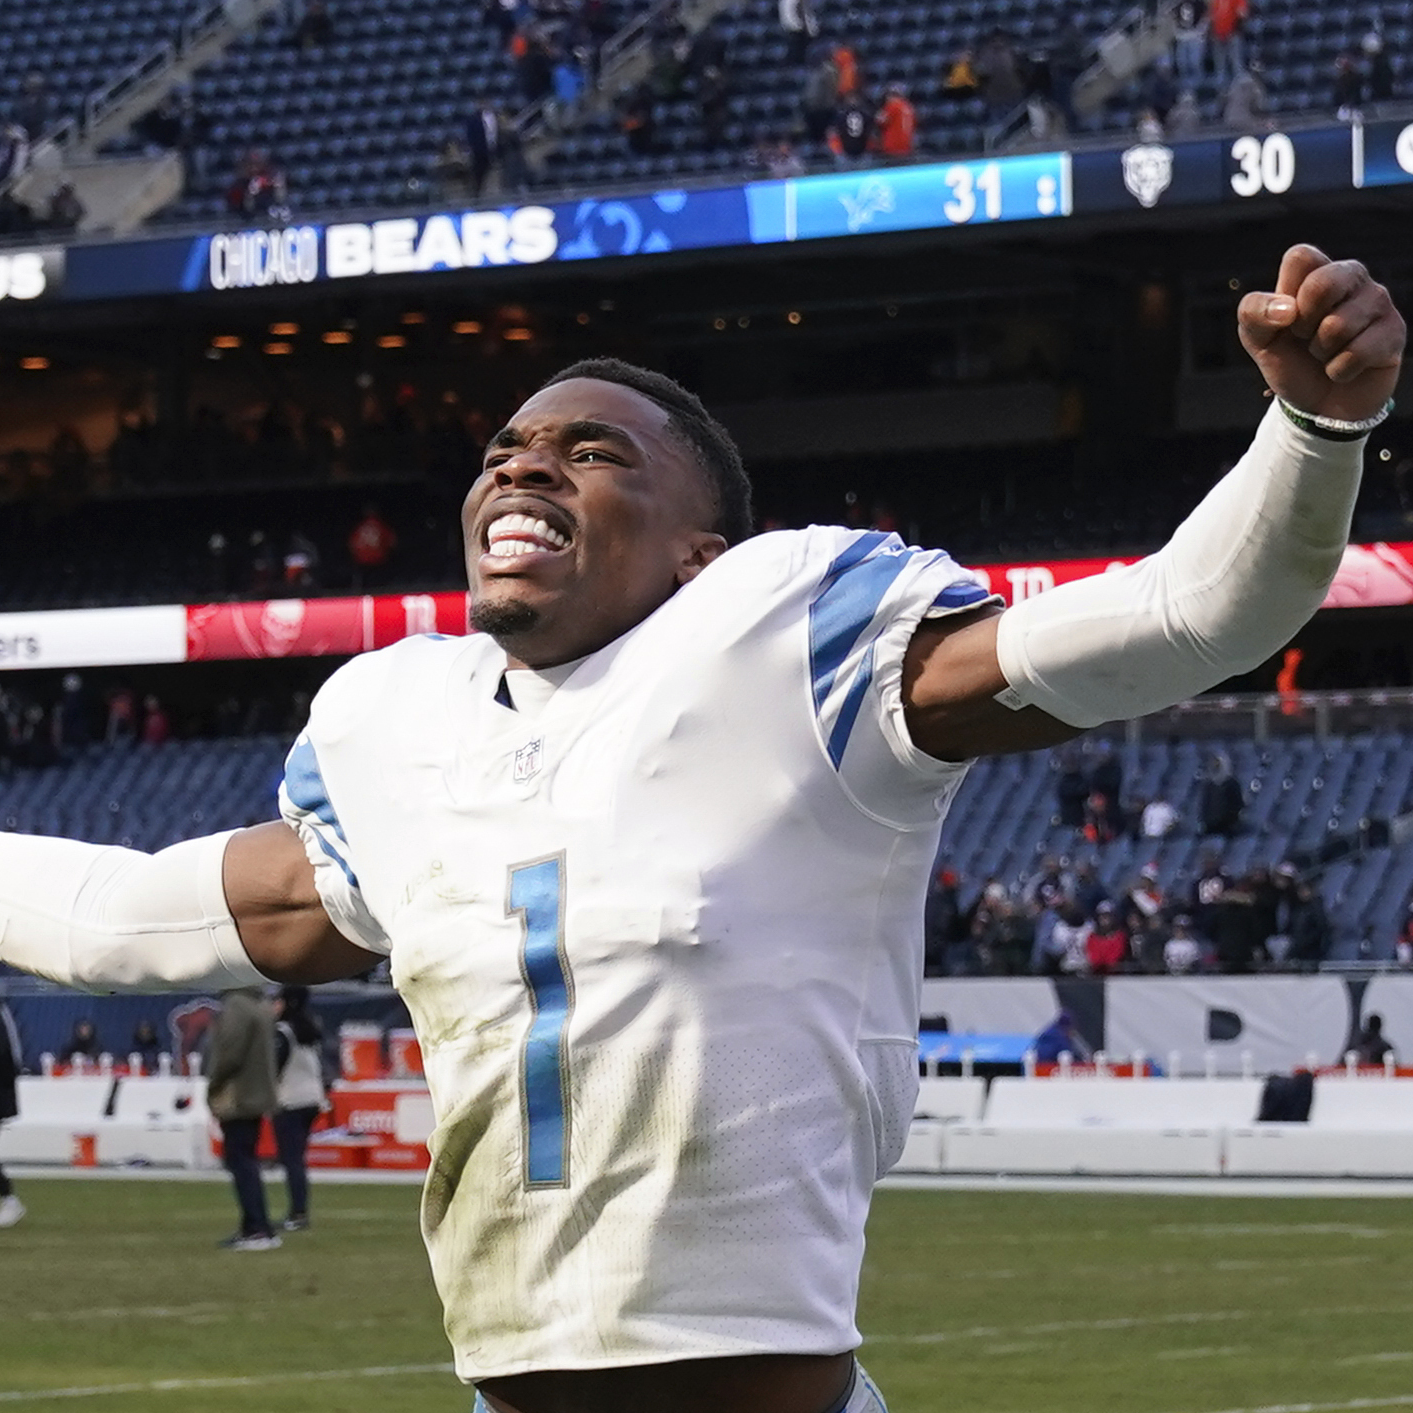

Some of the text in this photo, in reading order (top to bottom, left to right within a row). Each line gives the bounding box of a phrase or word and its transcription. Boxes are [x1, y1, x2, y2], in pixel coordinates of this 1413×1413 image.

[942, 160, 1004, 225] 31
[1230, 132, 1296, 197] 30
[209, 205, 559, 291] CHICAGO BEARS
[503, 847, 577, 1192] 1
